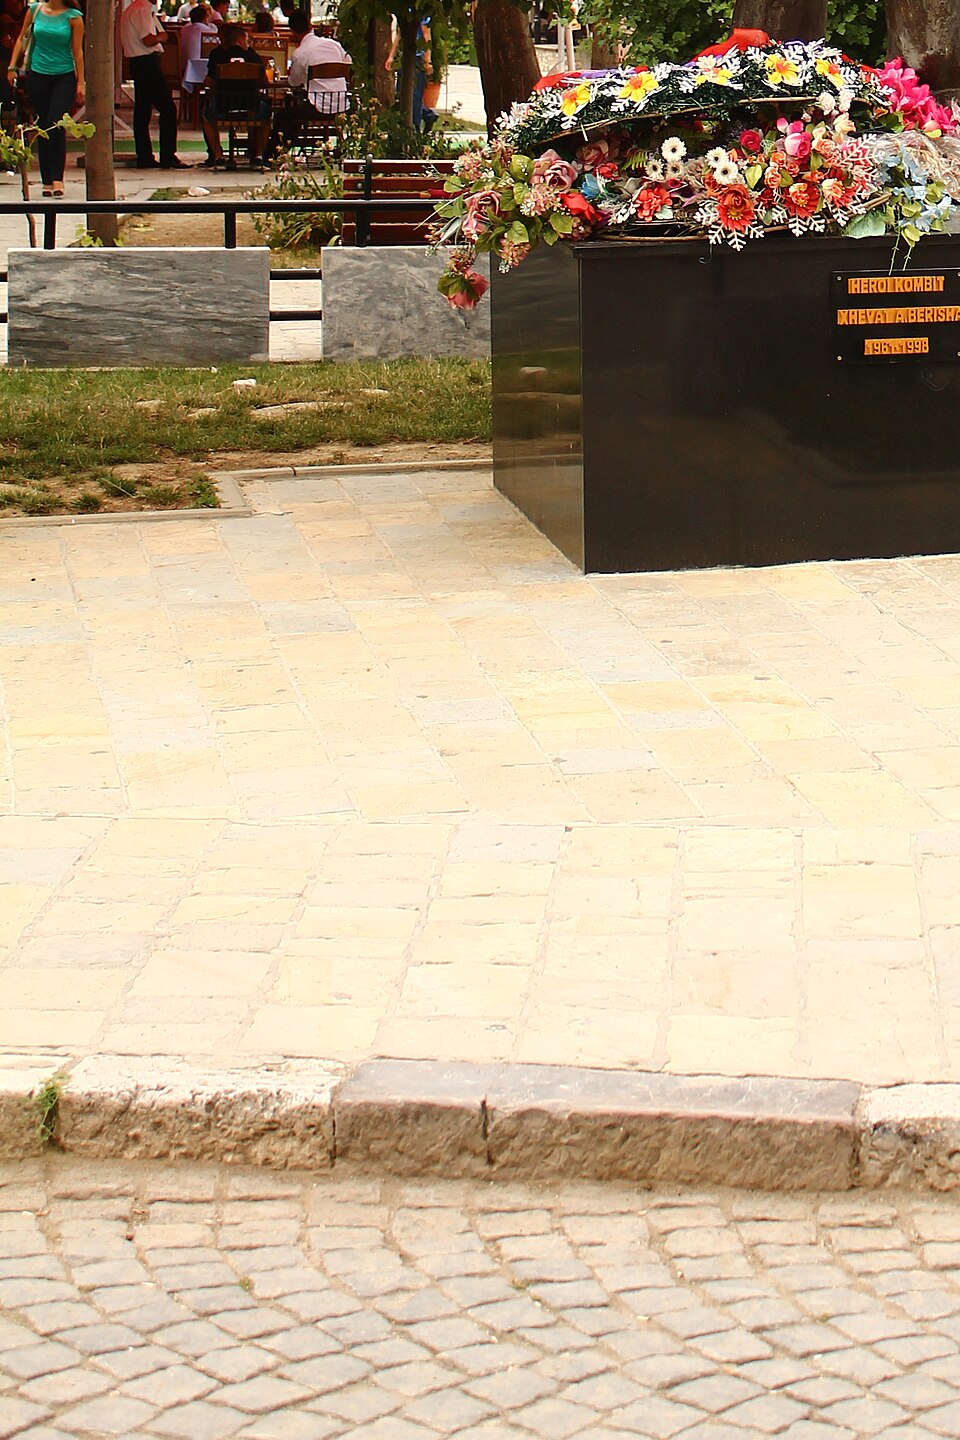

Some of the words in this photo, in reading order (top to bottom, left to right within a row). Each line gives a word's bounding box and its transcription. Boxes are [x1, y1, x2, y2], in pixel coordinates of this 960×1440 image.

[848, 277, 893, 294] HEROI
[894, 275, 945, 293] KOMBIT
[837, 308, 890, 325] XHEVAT
